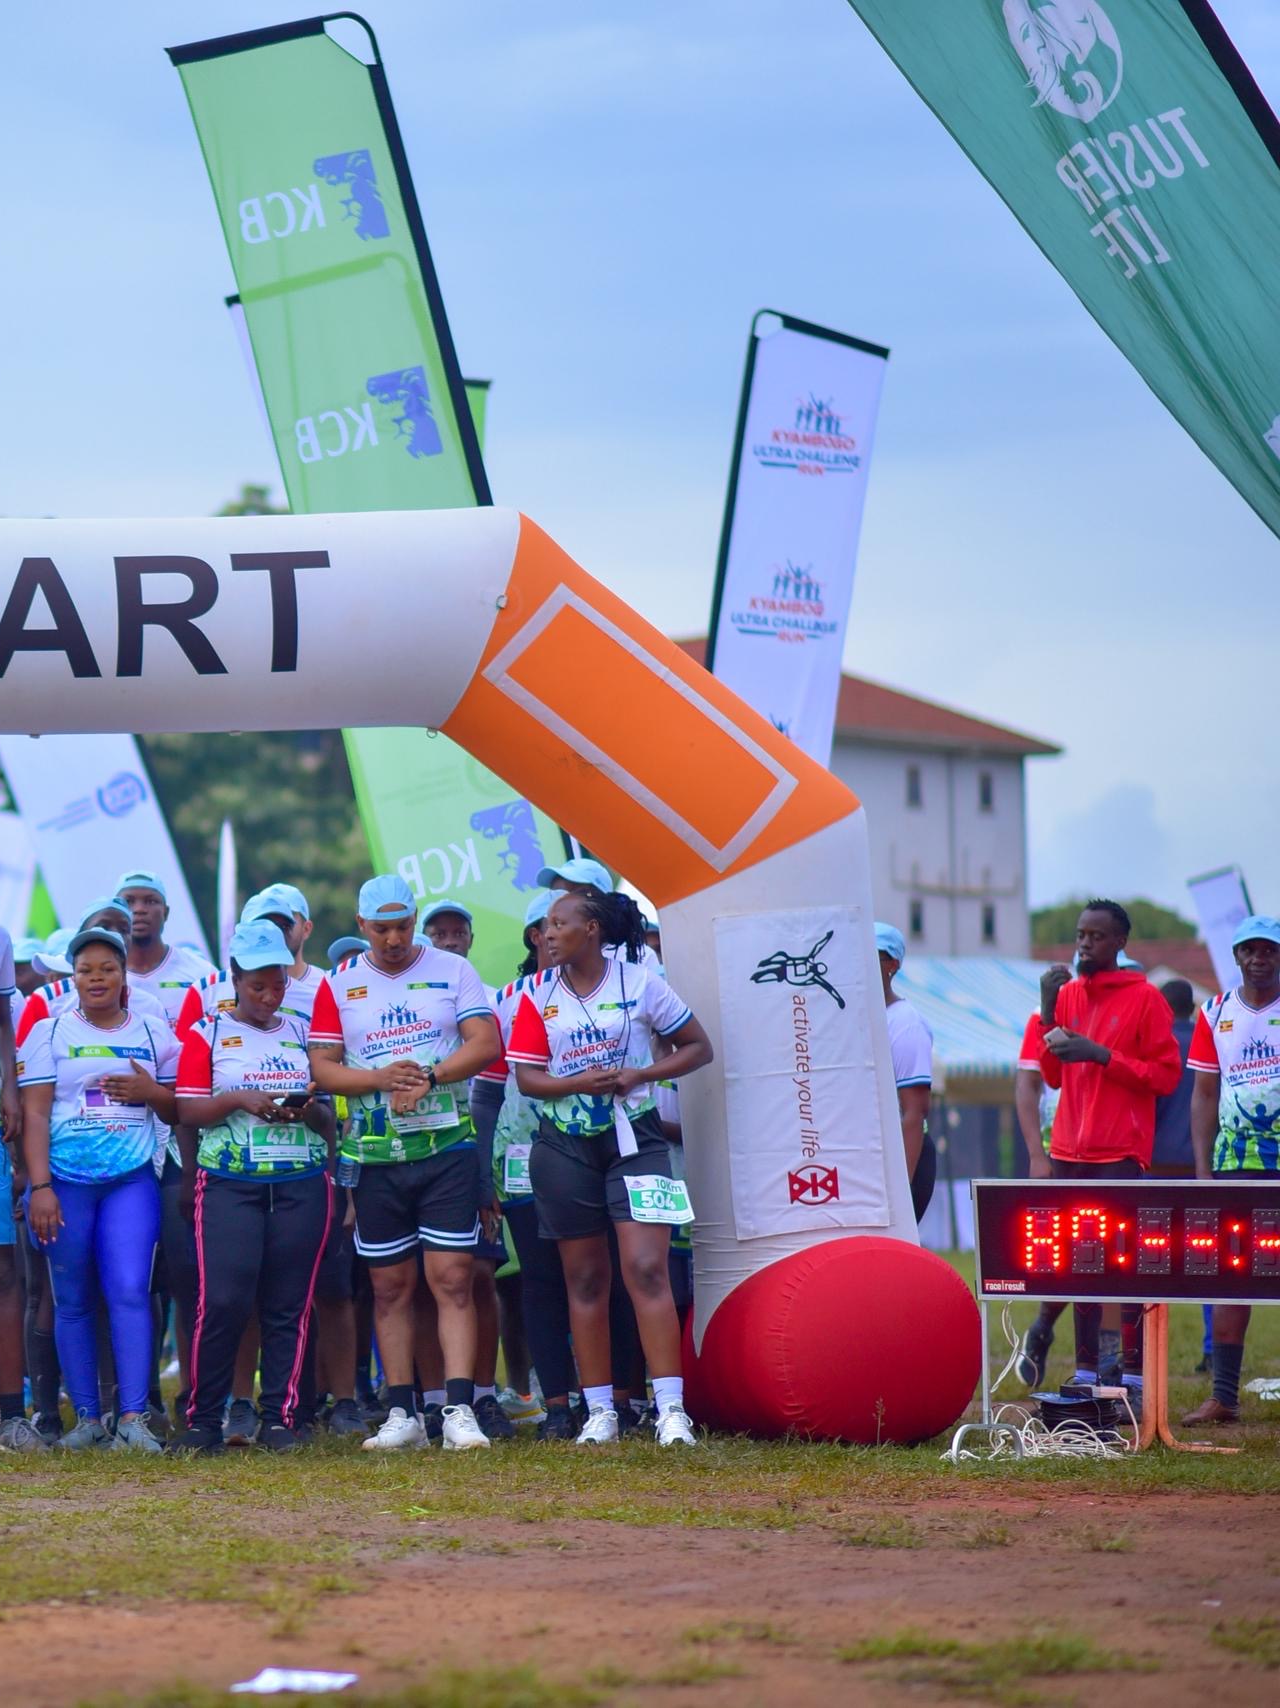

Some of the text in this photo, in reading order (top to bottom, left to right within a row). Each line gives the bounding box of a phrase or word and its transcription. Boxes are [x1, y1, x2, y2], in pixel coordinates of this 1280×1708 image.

[366, 1020, 432, 1042] KYAMBOGO
[360, 1029, 442, 1055] ULTRA CHALLENGE
[392, 1046, 413, 1056] RUN
[561, 1039, 619, 1062] KYAMBOGO
[1230, 1057, 1280, 1073] KYAMBOG
[1246, 1066, 1280, 1079] CHALLE
[243, 1071, 307, 1081] KYAMBOGO
[792, 995, 820, 1158] activate your life
[1250, 1076, 1269, 1085] RUN
[263, 1082, 308, 1091] CHALLEN
[407, 1095, 443, 1115] 04
[106, 1123, 127, 1132] RUN
[641, 1191, 677, 1210] 504
